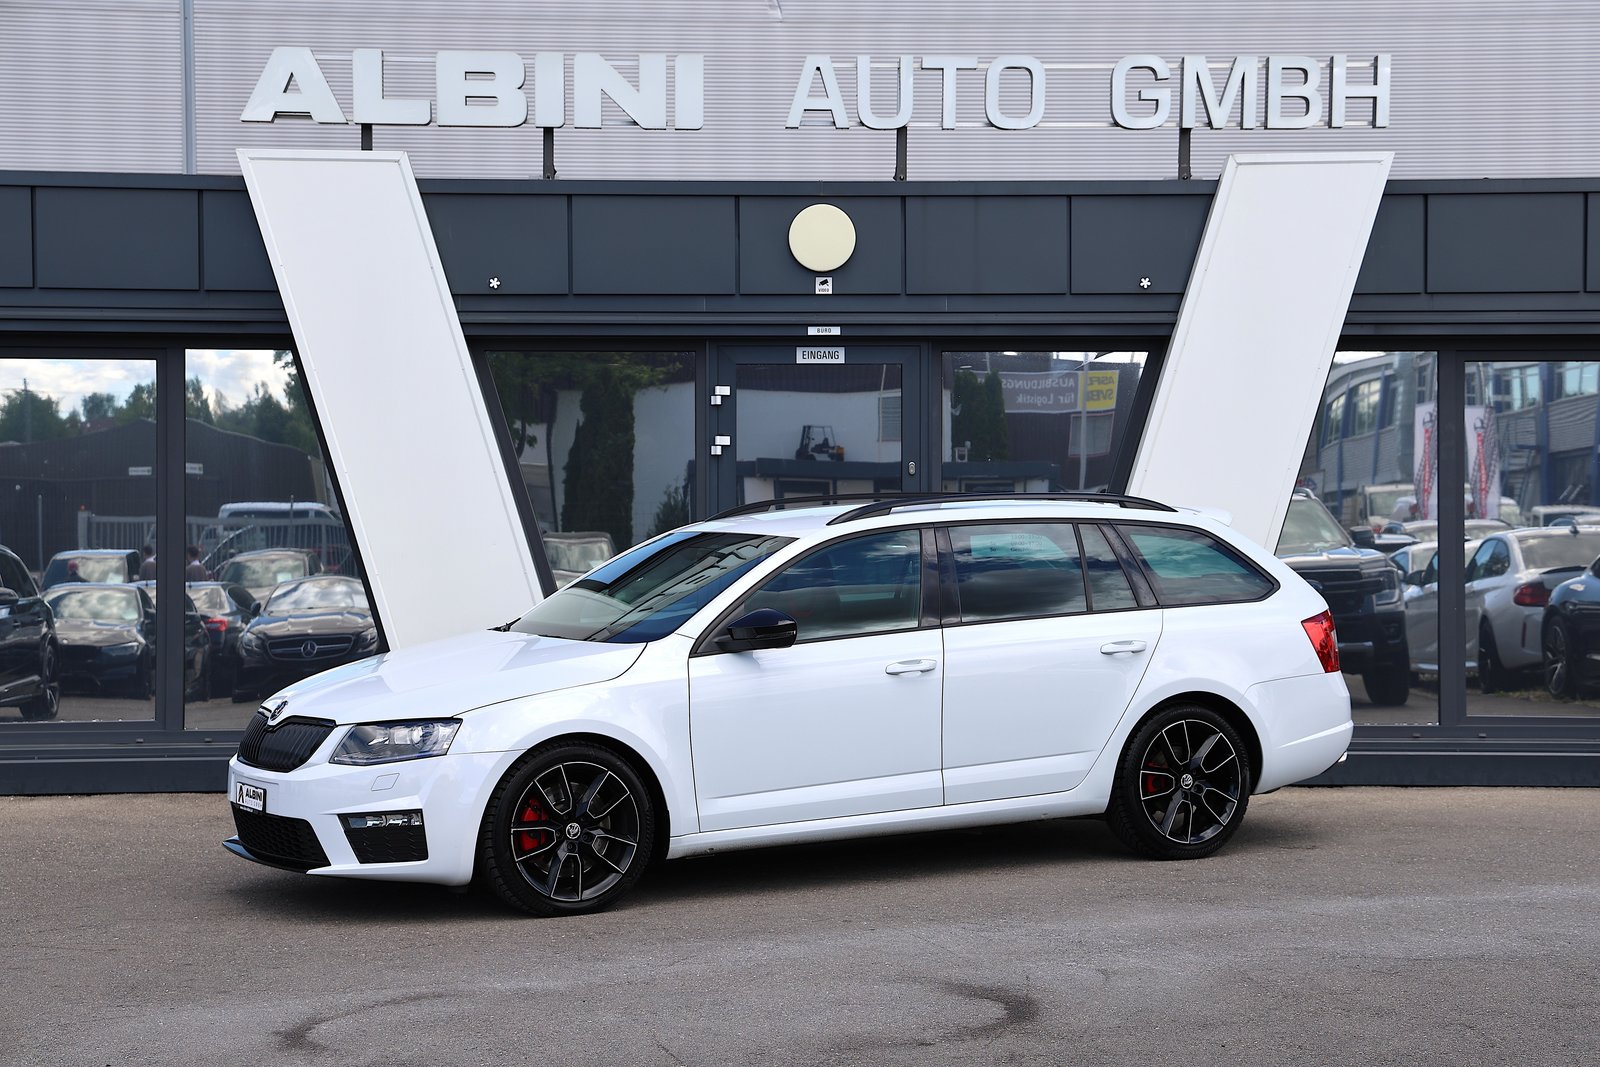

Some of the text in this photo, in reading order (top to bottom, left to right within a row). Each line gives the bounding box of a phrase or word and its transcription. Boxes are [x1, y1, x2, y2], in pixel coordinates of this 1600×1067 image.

[240, 46, 1392, 130] ALBINI AUTO GMBH
[802, 350, 840, 360] EINGANG
